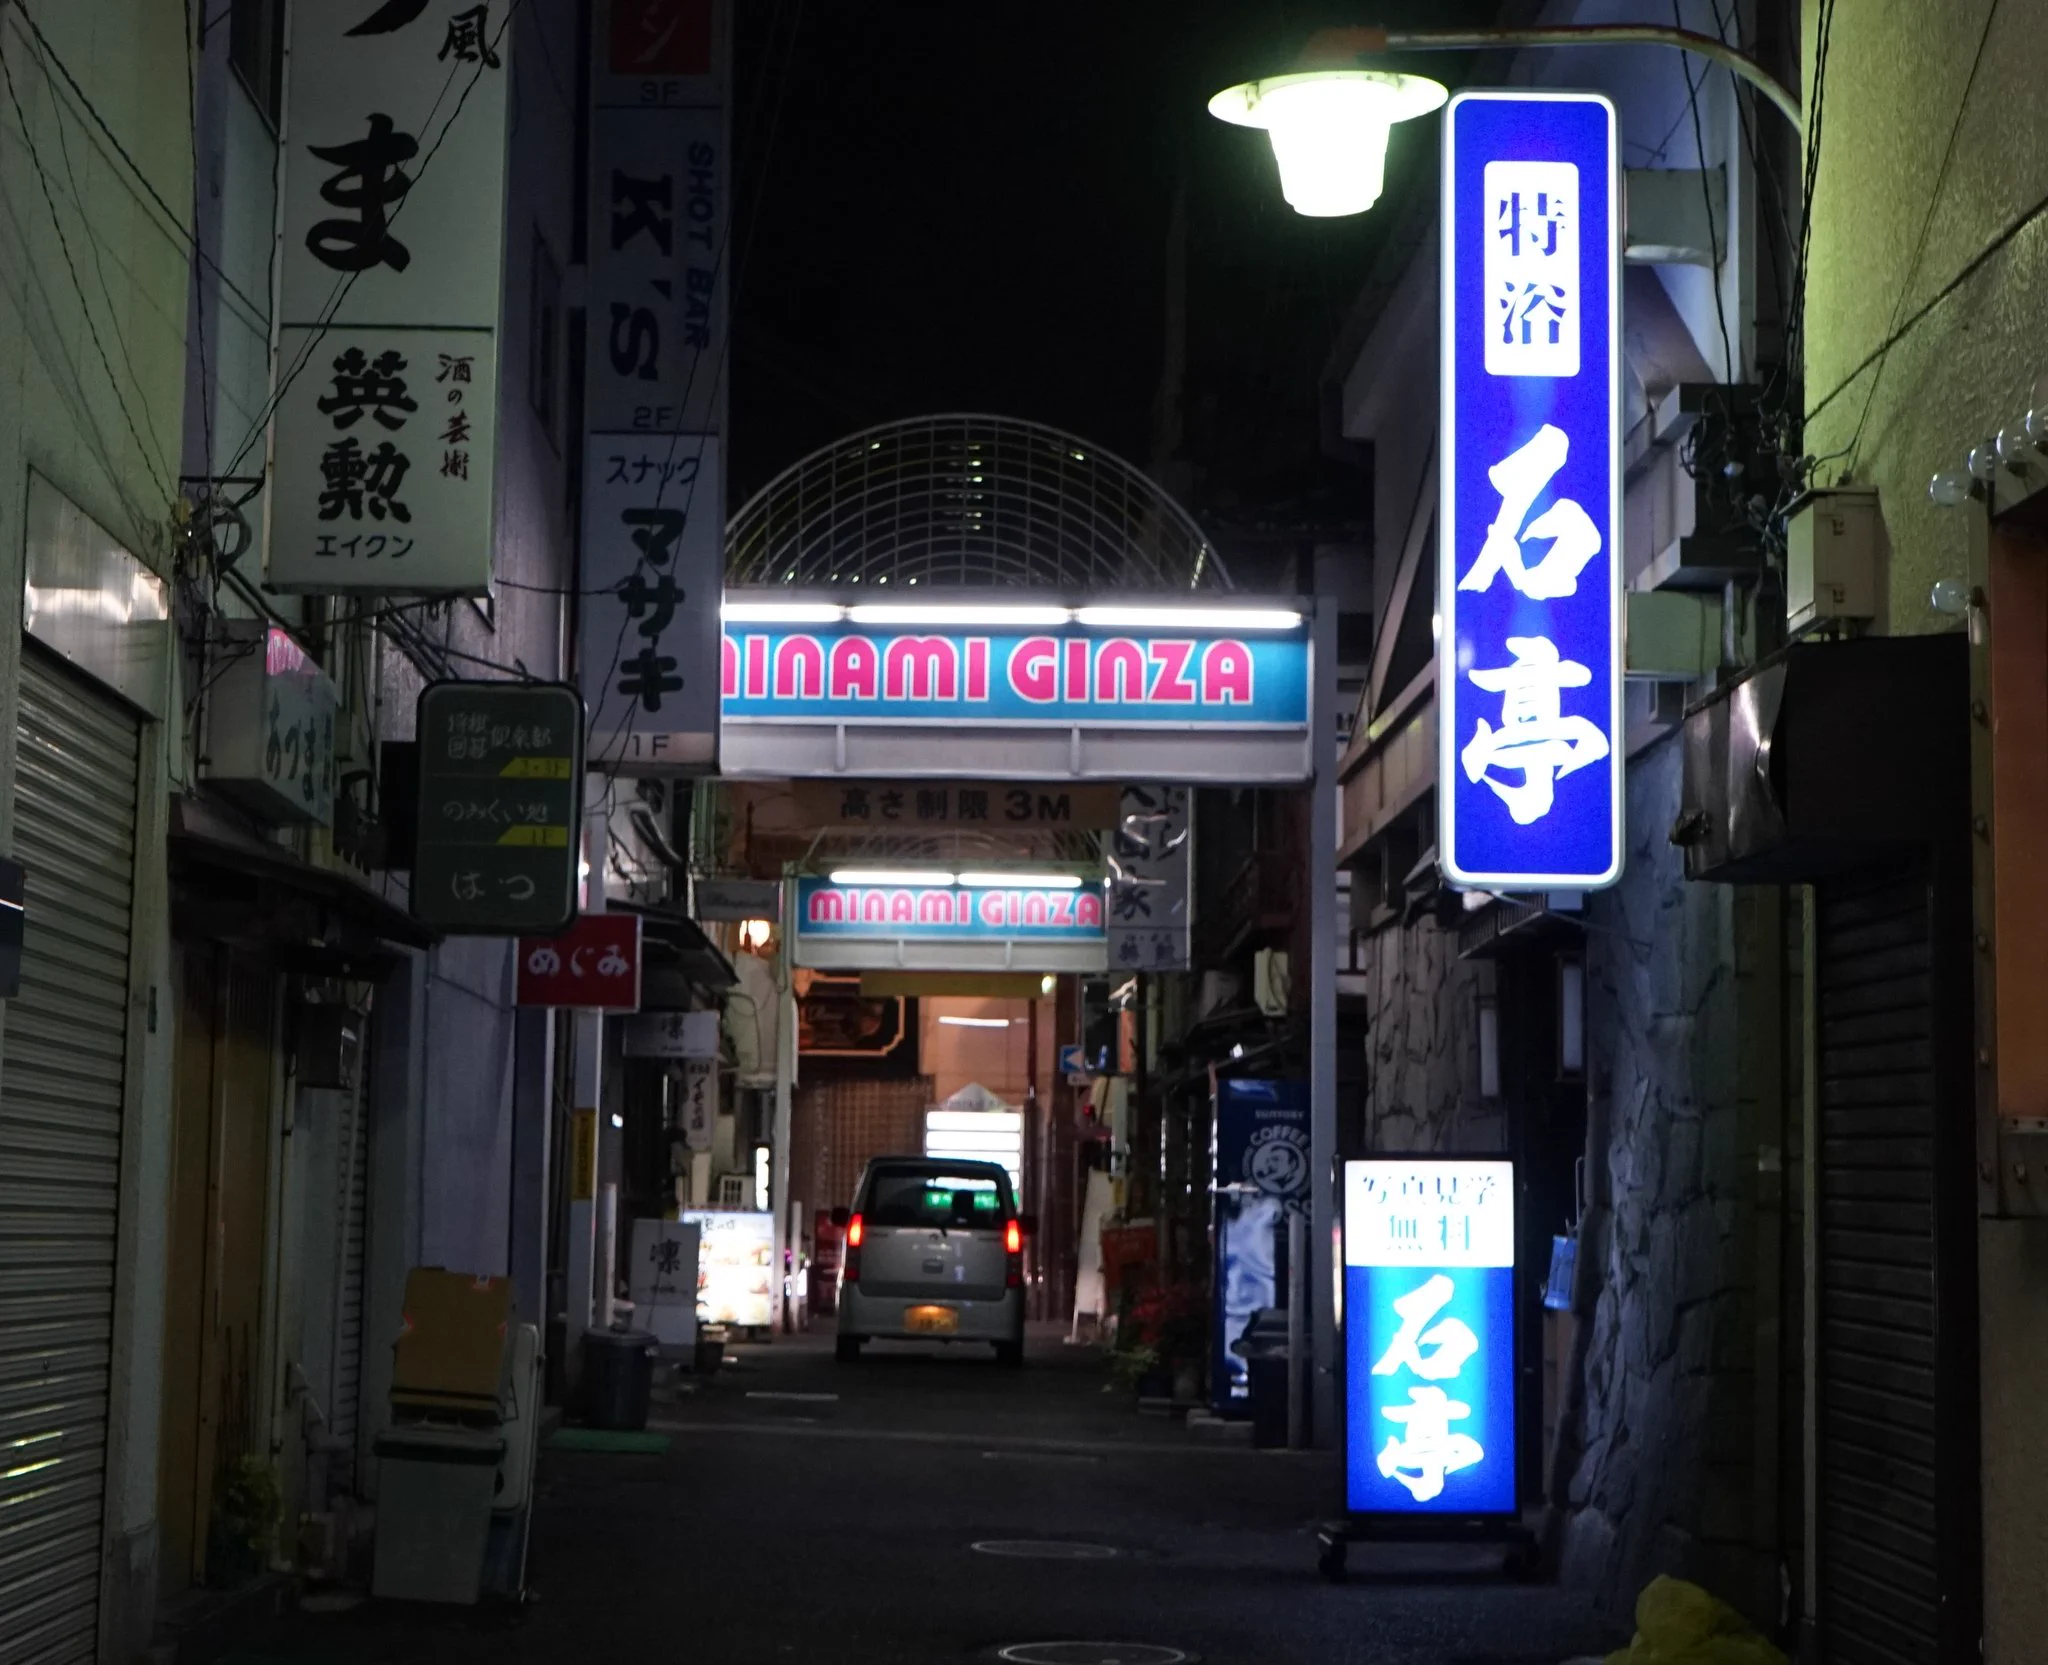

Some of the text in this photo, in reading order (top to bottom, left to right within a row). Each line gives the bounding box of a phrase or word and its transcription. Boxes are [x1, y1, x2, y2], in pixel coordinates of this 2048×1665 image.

[640, 81, 680, 104] 3F
[684, 141, 714, 349] SHOT BAR
[1498, 191, 1567, 345] 特浴
[436, 353, 475, 482] 酒の芸術
[634, 405, 674, 428] 2F
[606, 455, 700, 486] スナック
[316, 535, 414, 559] エイクン
[616, 507, 687, 713] マサキ
[1457, 423, 1609, 825] 石亭
[722, 634, 1254, 706] INAMI GINZA
[633, 734, 670, 757] 1F
[840, 788, 990, 822] 高さ制限
[808, 888, 972, 926] MINAMI
[979, 889, 1102, 927] GINZA
[528, 945, 630, 979] めぐみ
[1387, 1213, 1471, 1252] 無料
[1371, 1273, 1485, 1502] 石亭
